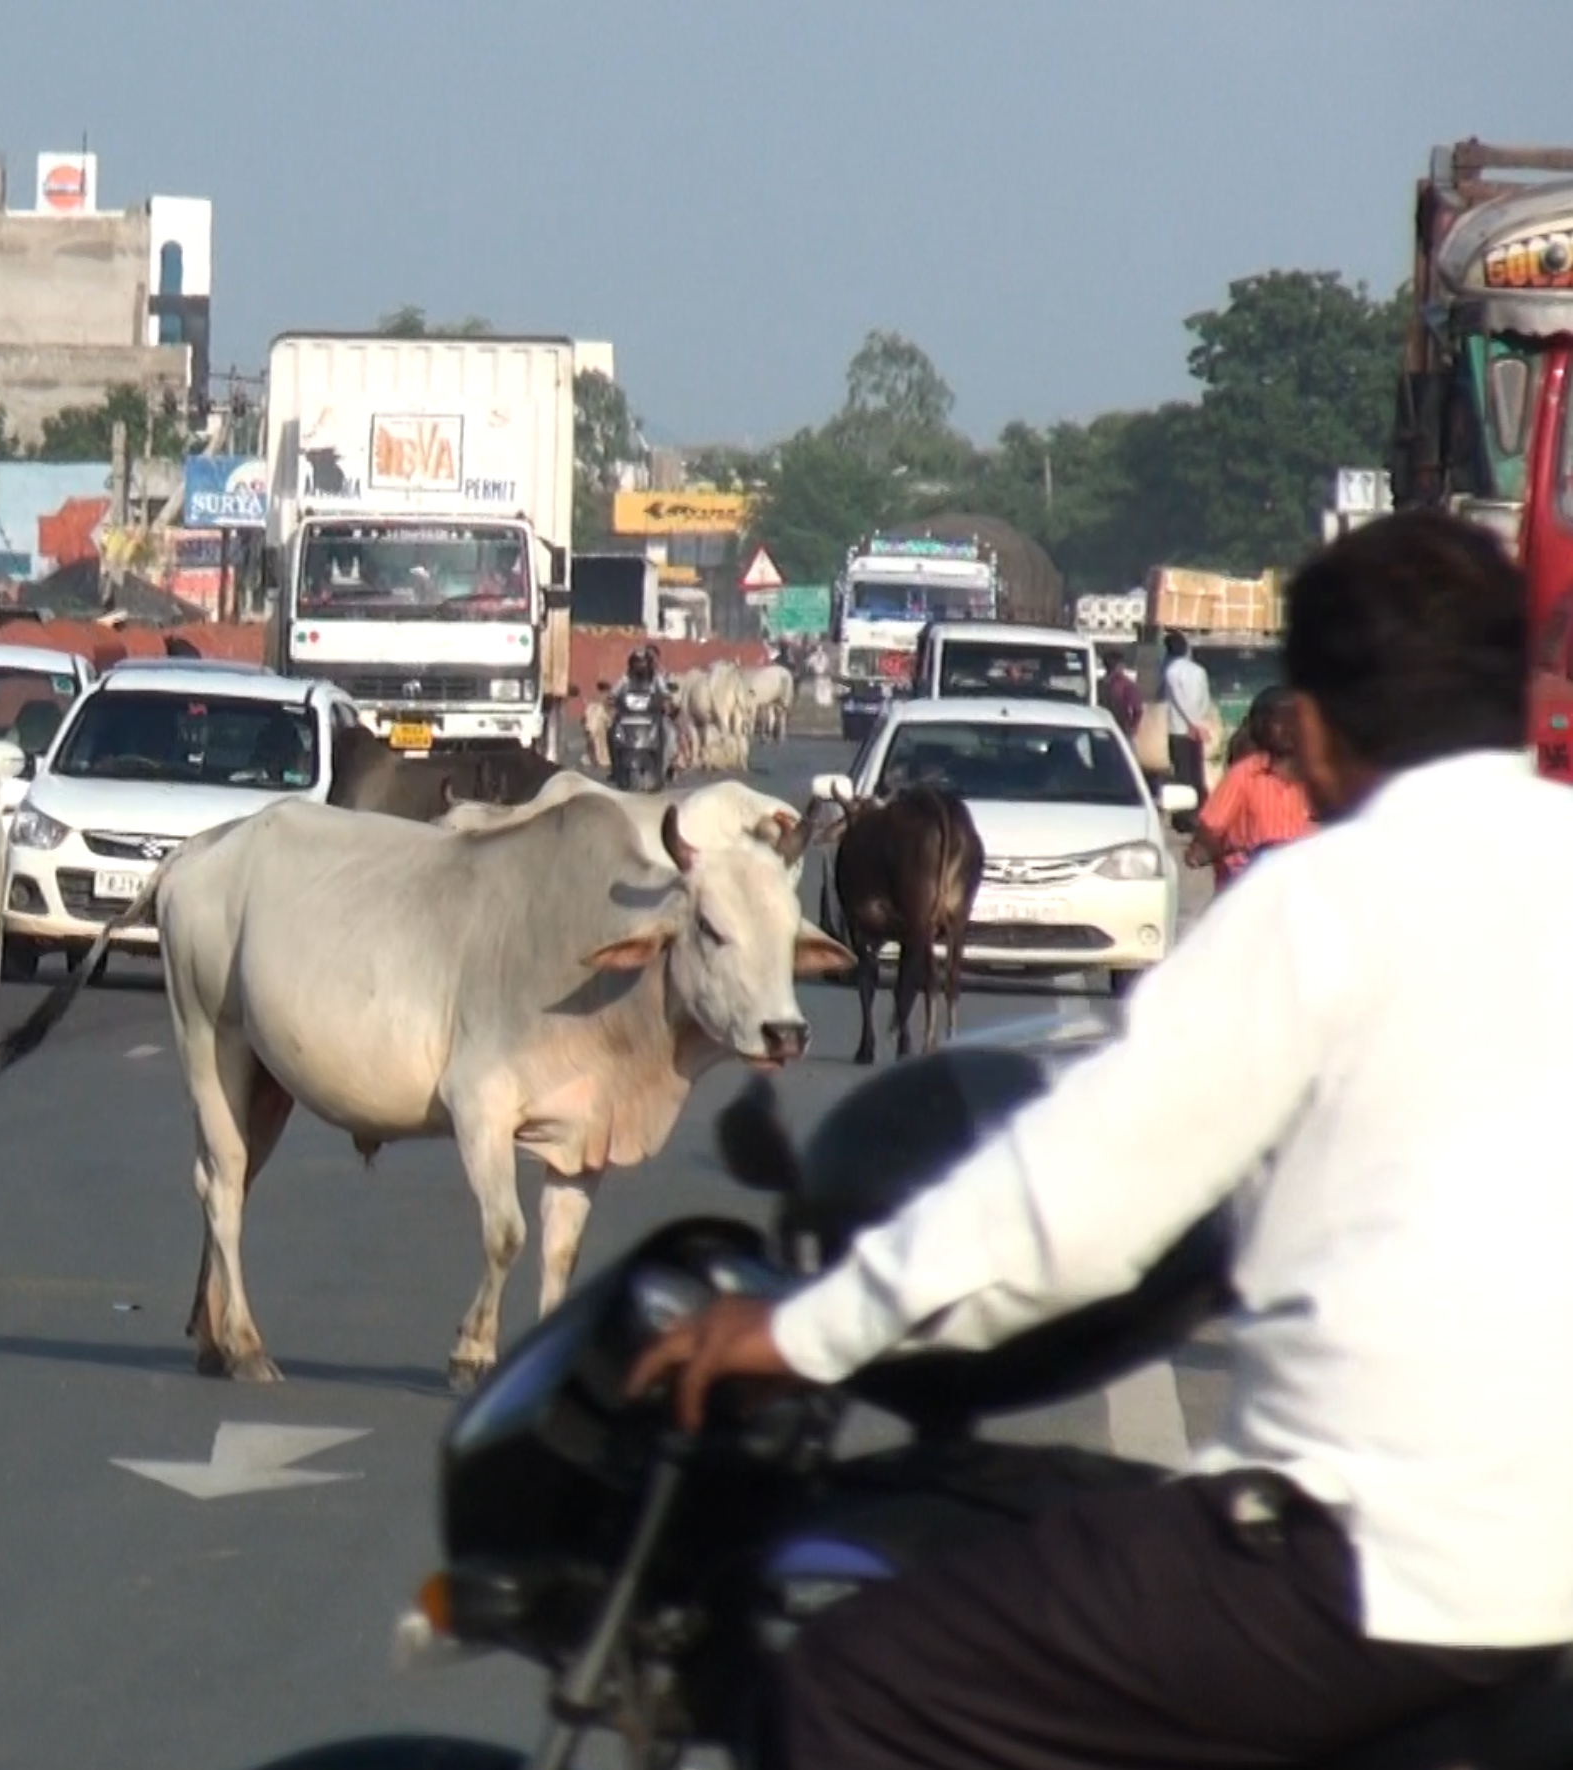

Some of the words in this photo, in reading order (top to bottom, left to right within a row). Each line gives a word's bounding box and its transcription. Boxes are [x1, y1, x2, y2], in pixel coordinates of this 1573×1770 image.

[1486, 232, 1573, 287] GOO
[464, 478, 516, 502] PERMIT
[191, 491, 264, 515] SURYA
